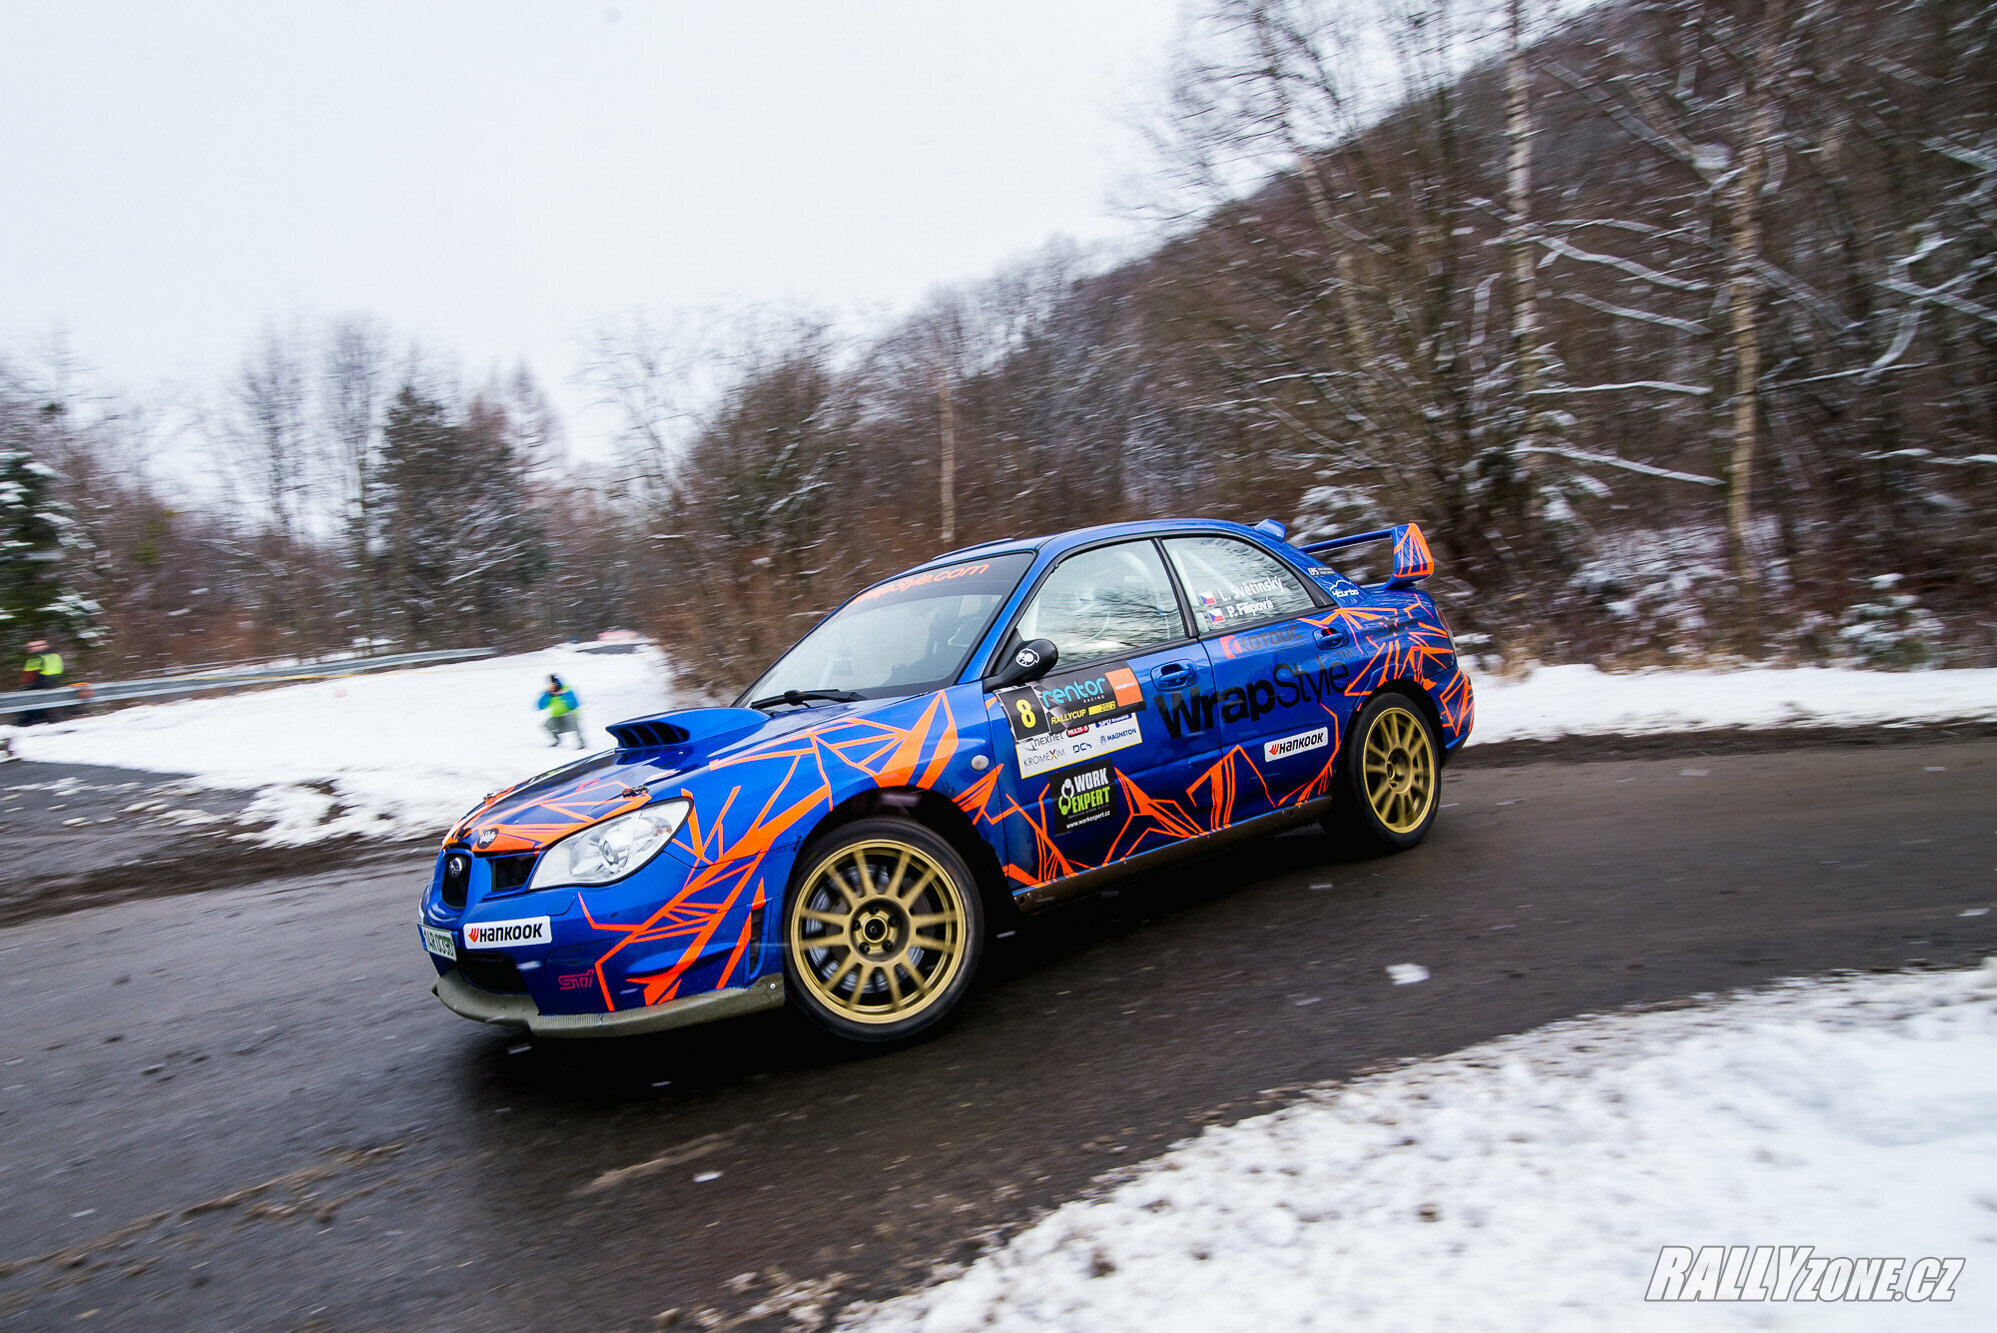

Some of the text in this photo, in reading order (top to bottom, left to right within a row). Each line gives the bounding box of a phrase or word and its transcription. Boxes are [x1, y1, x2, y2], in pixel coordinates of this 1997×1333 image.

[1041, 677, 1106, 708] rentor
[1153, 655, 1350, 740] WrapStyle
[1015, 699, 1036, 729] 8
[1050, 708, 1087, 725] RALLYCUP
[1107, 728, 1137, 742] MAGNETON
[1023, 748, 1066, 767] KROMEXIM
[1073, 767, 1109, 793] WORK
[1071, 786, 1111, 814] EXPERT
